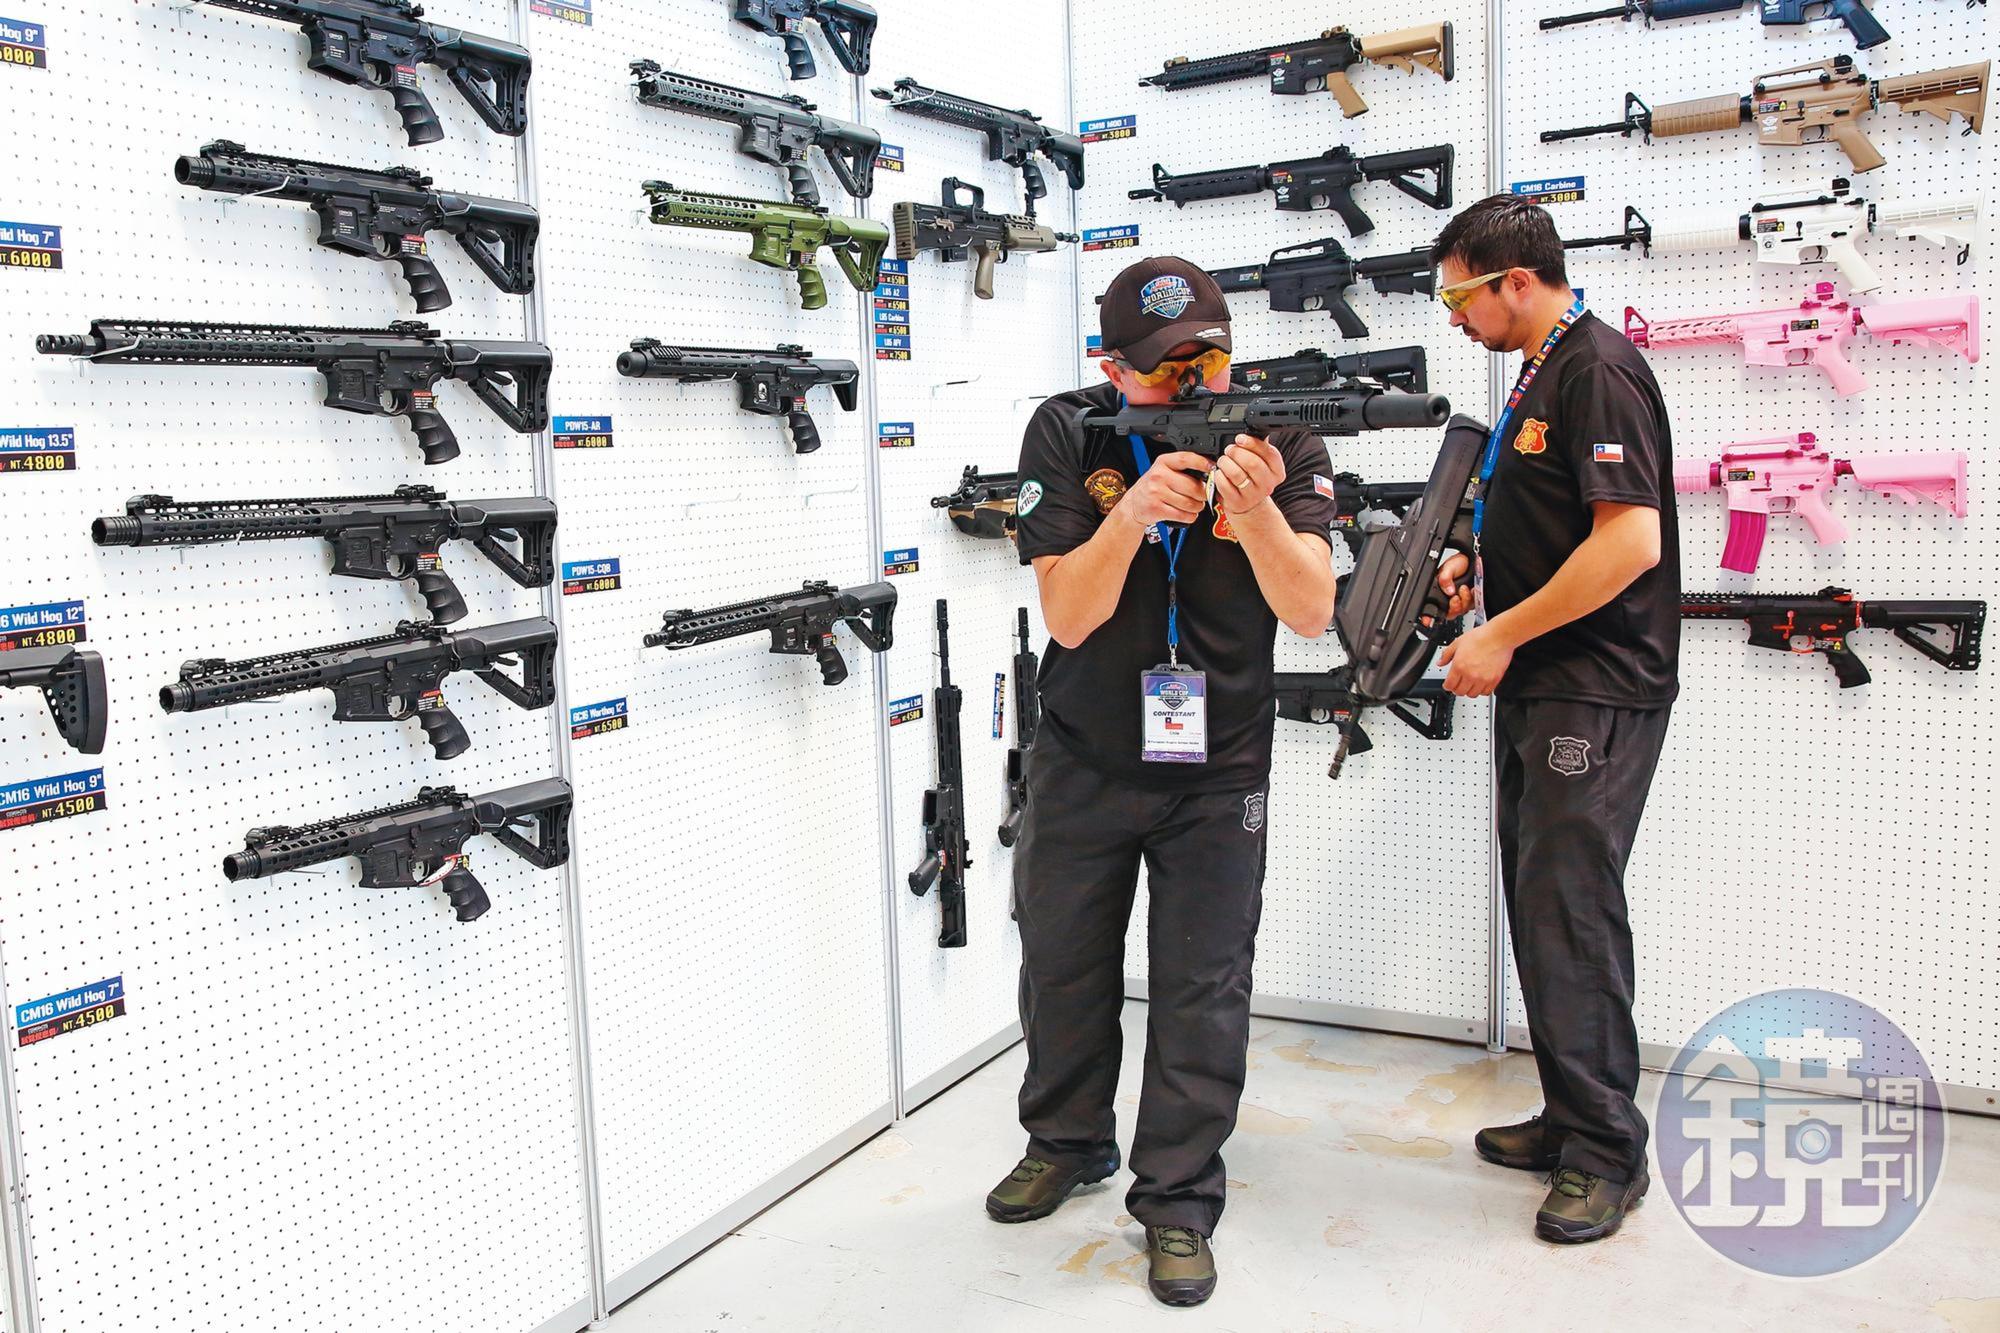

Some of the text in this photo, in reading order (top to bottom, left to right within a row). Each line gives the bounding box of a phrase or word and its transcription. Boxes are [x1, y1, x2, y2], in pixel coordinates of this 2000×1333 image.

[0, 46, 35, 66] 000
[0, 226, 14, 242] ild
[17, 228, 40, 246] Hog
[1143, 288, 1176, 306] WORLD
[24, 433, 46, 450] Hog
[10, 454, 65, 471] NT.4800
[0, 614, 10, 629] 6
[12, 611, 39, 627] Wild
[40, 609, 63, 625] Hog
[22, 628, 76, 648] NT.4800
[0, 787, 31, 807] CM16
[34, 782, 61, 799] Wild
[63, 779, 86, 793] Hog
[42, 796, 95, 818] NT.4500
[21, 1002, 54, 1023] CM16
[56, 993, 82, 1012] Wild
[84, 989, 106, 1005] Hog
[63, 1004, 115, 1031] NT.4500
